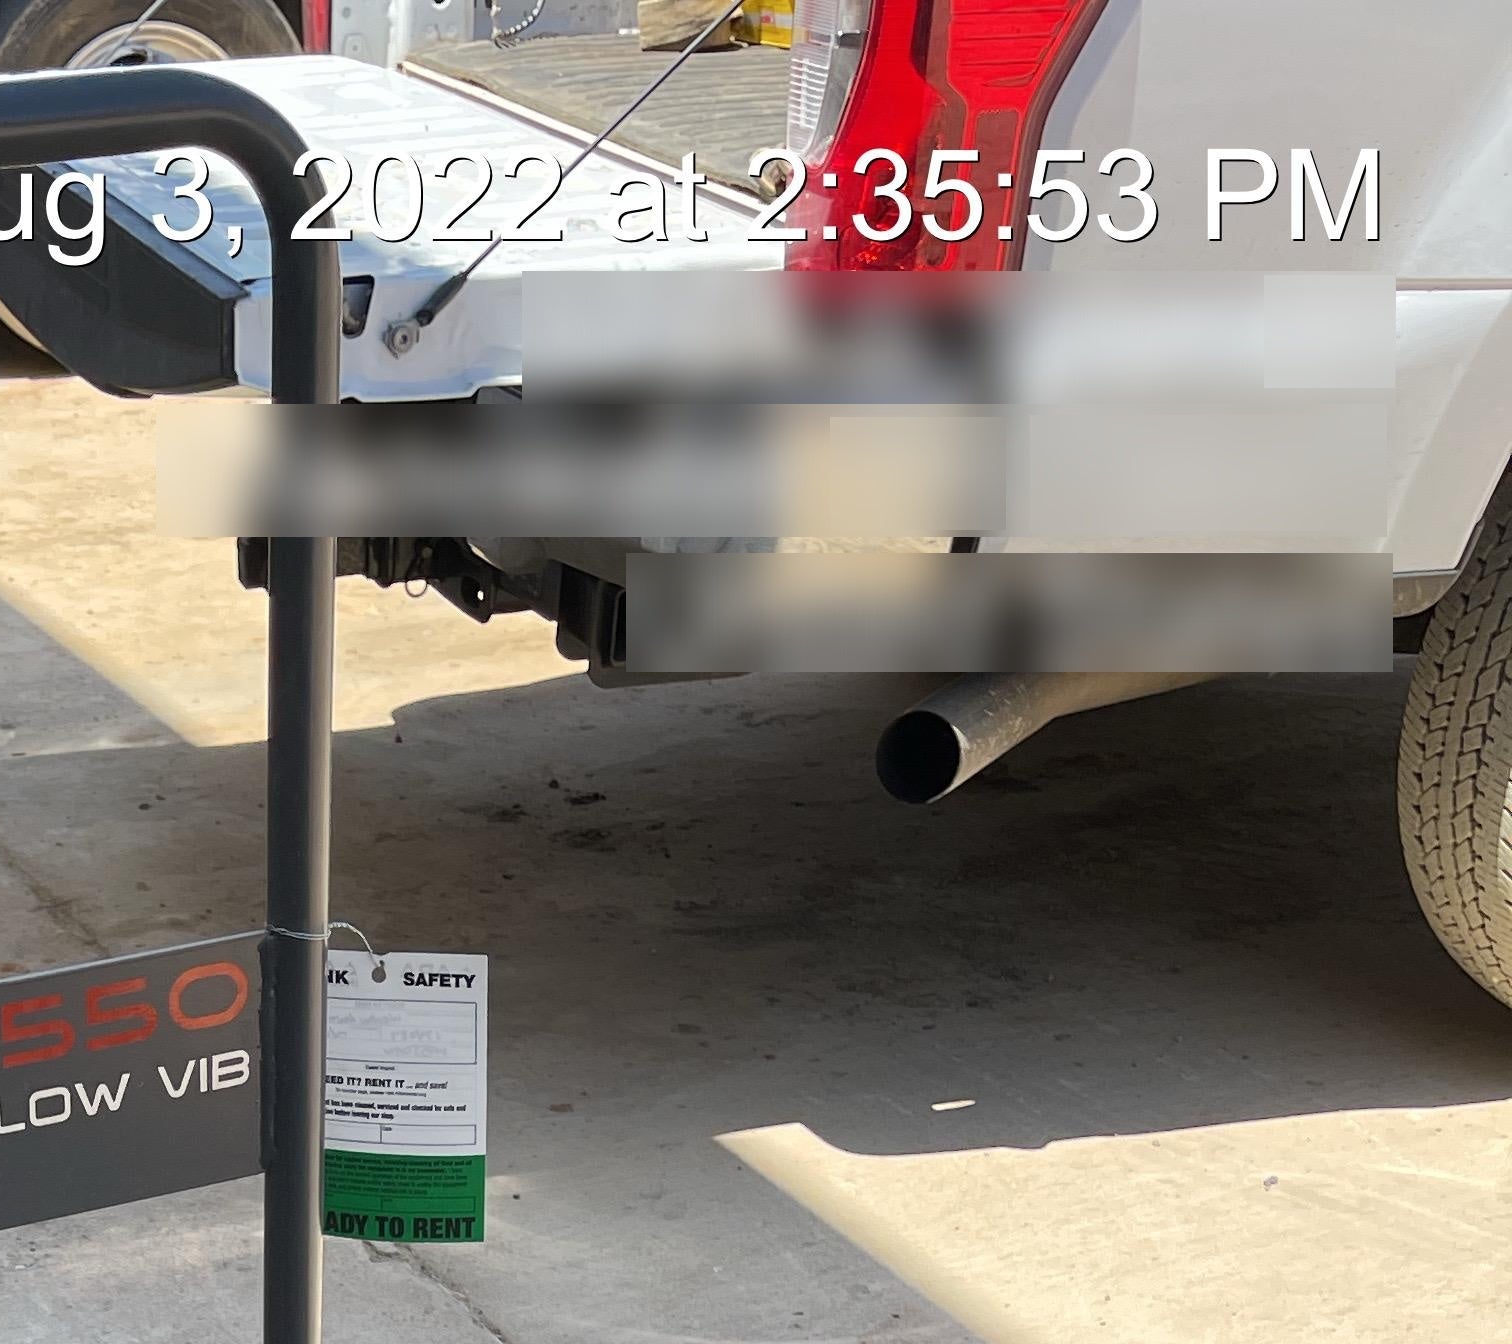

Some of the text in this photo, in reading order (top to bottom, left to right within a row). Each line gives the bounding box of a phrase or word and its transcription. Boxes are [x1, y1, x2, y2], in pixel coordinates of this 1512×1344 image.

[402, 972, 477, 988] SAFETY
[156, 1049, 251, 1099] VIB
[325, 1074, 344, 1085] EED
[364, 1078, 393, 1088] RENT
[394, 1079, 406, 1089] IT
[324, 1210, 477, 1239] ADY TO RENT
